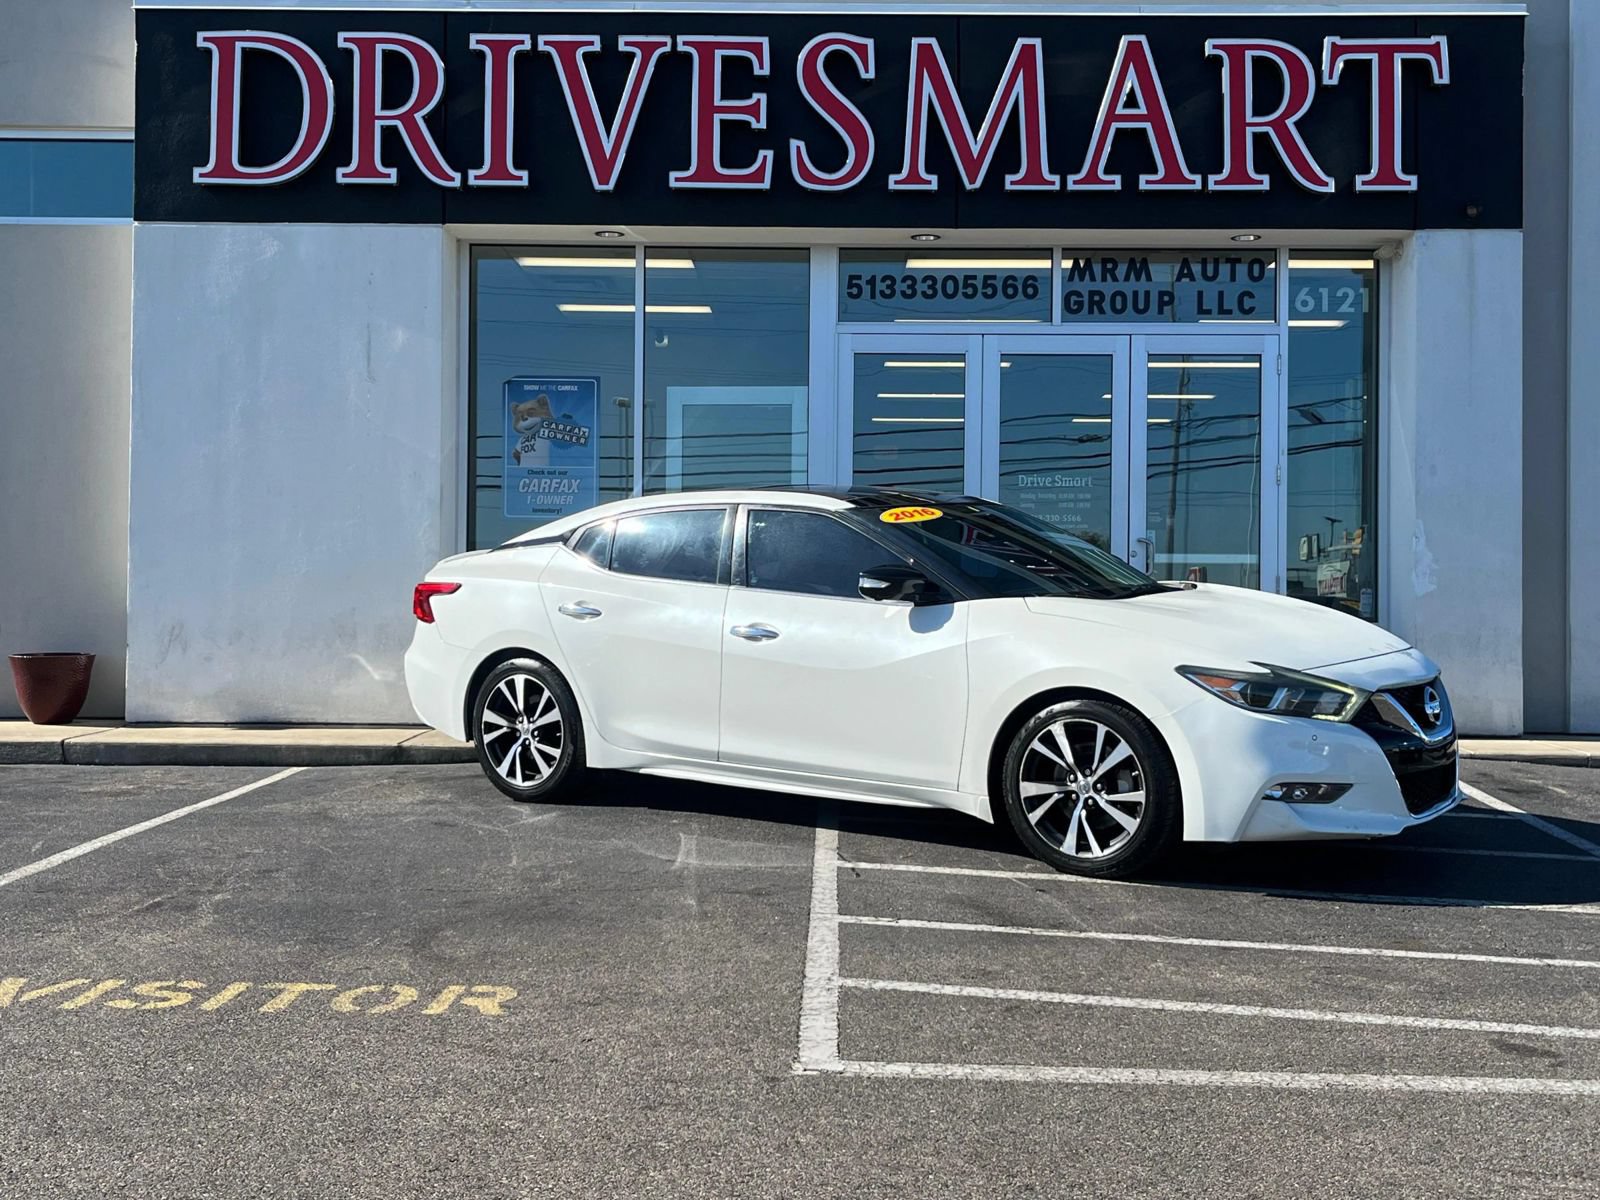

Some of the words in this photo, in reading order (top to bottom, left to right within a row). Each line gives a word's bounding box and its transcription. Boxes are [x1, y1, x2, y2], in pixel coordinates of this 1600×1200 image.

[193, 29, 1450, 194] DRIVESMART
[1067, 257, 1152, 282] MRM
[1175, 257, 1266, 282] AUTO
[846, 274, 1040, 300] 5133305566
[1063, 290, 1175, 315] GROUP
[1196, 290, 1256, 315] LLC
[1295, 287, 1369, 313] 6121
[543, 421, 588, 437] CARFAX
[518, 478, 580, 493] CARFAX
[1018, 474, 1052, 487] Drive
[1054, 474, 1093, 488] Smart
[526, 495, 574, 505] 1-OWNER
[888, 508, 935, 521] 2016
[0, 977, 518, 1015] VISITOR
